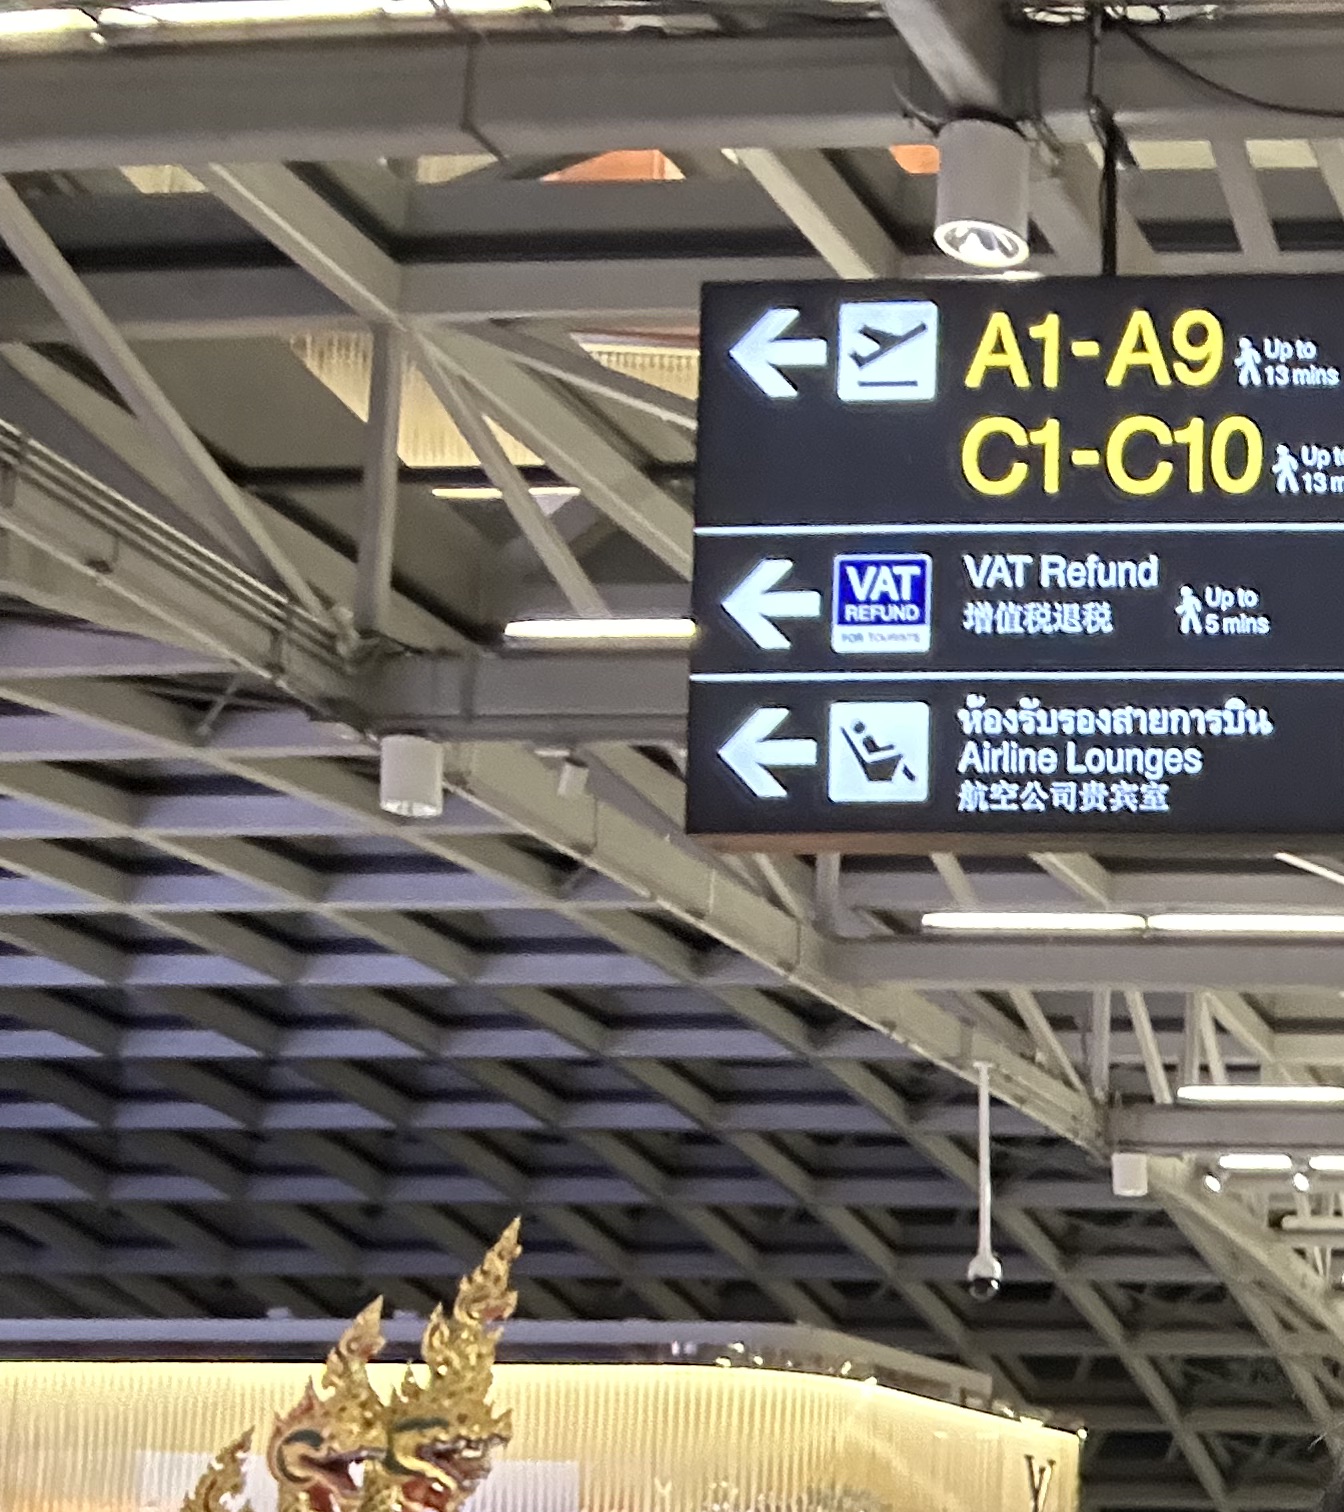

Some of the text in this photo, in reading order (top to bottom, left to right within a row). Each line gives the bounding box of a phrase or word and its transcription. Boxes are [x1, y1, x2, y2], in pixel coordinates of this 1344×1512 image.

[965, 309, 1223, 388] A1-A9
[1263, 338, 1317, 362] Up to
[1265, 364, 1340, 387] 13 mins
[962, 416, 1262, 496] C1-C10
[1301, 445, 1327, 470] Up
[846, 564, 921, 602] VAT
[963, 554, 1158, 589] VAT Refund
[843, 603, 921, 622] REFUND
[1205, 586, 1259, 611] Up to
[963, 601, 1113, 634] 增值税退税
[1205, 613, 1270, 634] 5 mins
[957, 694, 1273, 736] ห้องรับรองสายการบิน
[958, 741, 1202, 782] Airline Lounges
[957, 780, 1169, 812] 航空公司贵宾室
